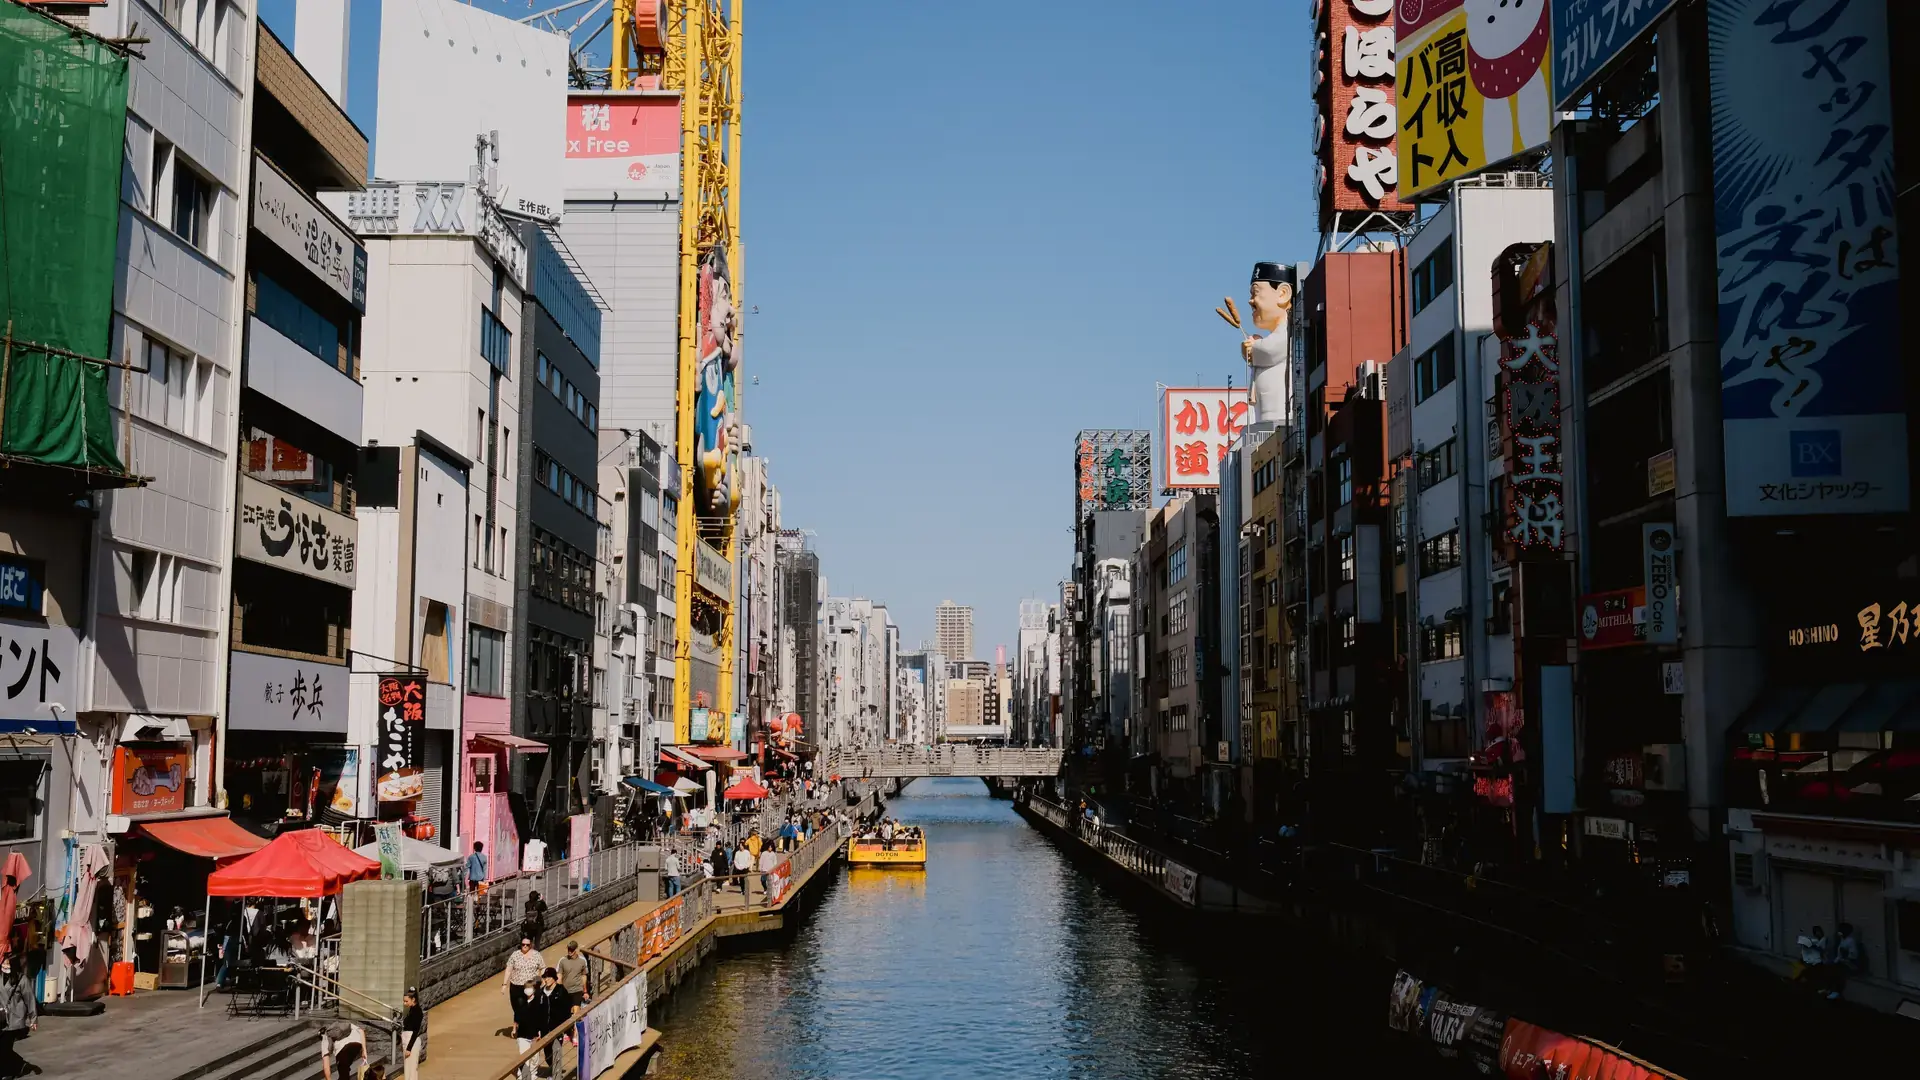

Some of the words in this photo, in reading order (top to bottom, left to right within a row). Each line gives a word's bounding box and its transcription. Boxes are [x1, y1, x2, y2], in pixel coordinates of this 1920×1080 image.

[581, 103, 611, 132] 税
[1403, 42, 1434, 187] バイト
[1434, 27, 1468, 177] 高収入
[587, 136, 630, 153] Free
[305, 218, 344, 283] 温野菜
[1174, 400, 1248, 436] かに
[1500, 322, 1563, 550] 大阪王将
[1175, 440, 1236, 476] 道
[1796, 441, 1835, 465] BX
[1106, 448, 1129, 504] 千房
[1759, 482, 1883, 502] 文化シャッター
[260, 497, 331, 571] うなぎ
[331, 534, 355, 574] 菱富
[1652, 554, 1667, 599] ZERO
[1598, 612, 1633, 629] MITHILA
[1789, 624, 1839, 646] HOSHINO
[290, 669, 324, 720] 歩兵
[403, 681, 423, 721] 大阪
